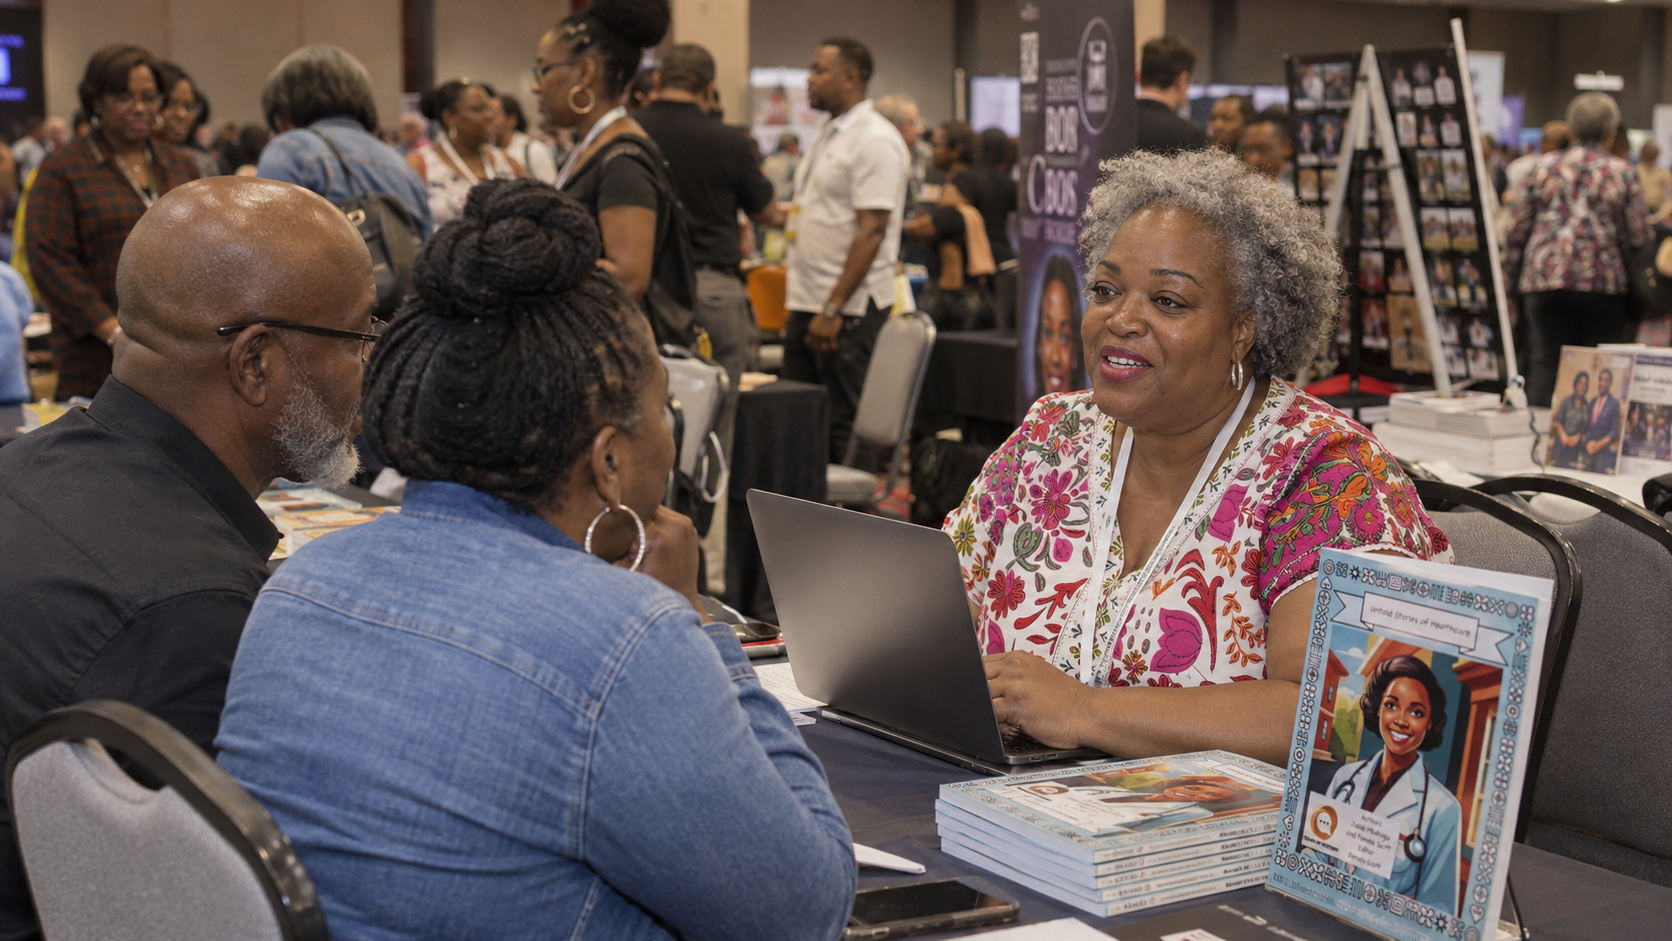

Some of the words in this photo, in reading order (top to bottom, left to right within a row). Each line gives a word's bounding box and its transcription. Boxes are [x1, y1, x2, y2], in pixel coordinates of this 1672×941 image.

[1370, 605, 1393, 618] Untold
[1394, 611, 1419, 625] Stories
[1420, 615, 1429, 626] of
[1430, 620, 1471, 638] Healthcare
